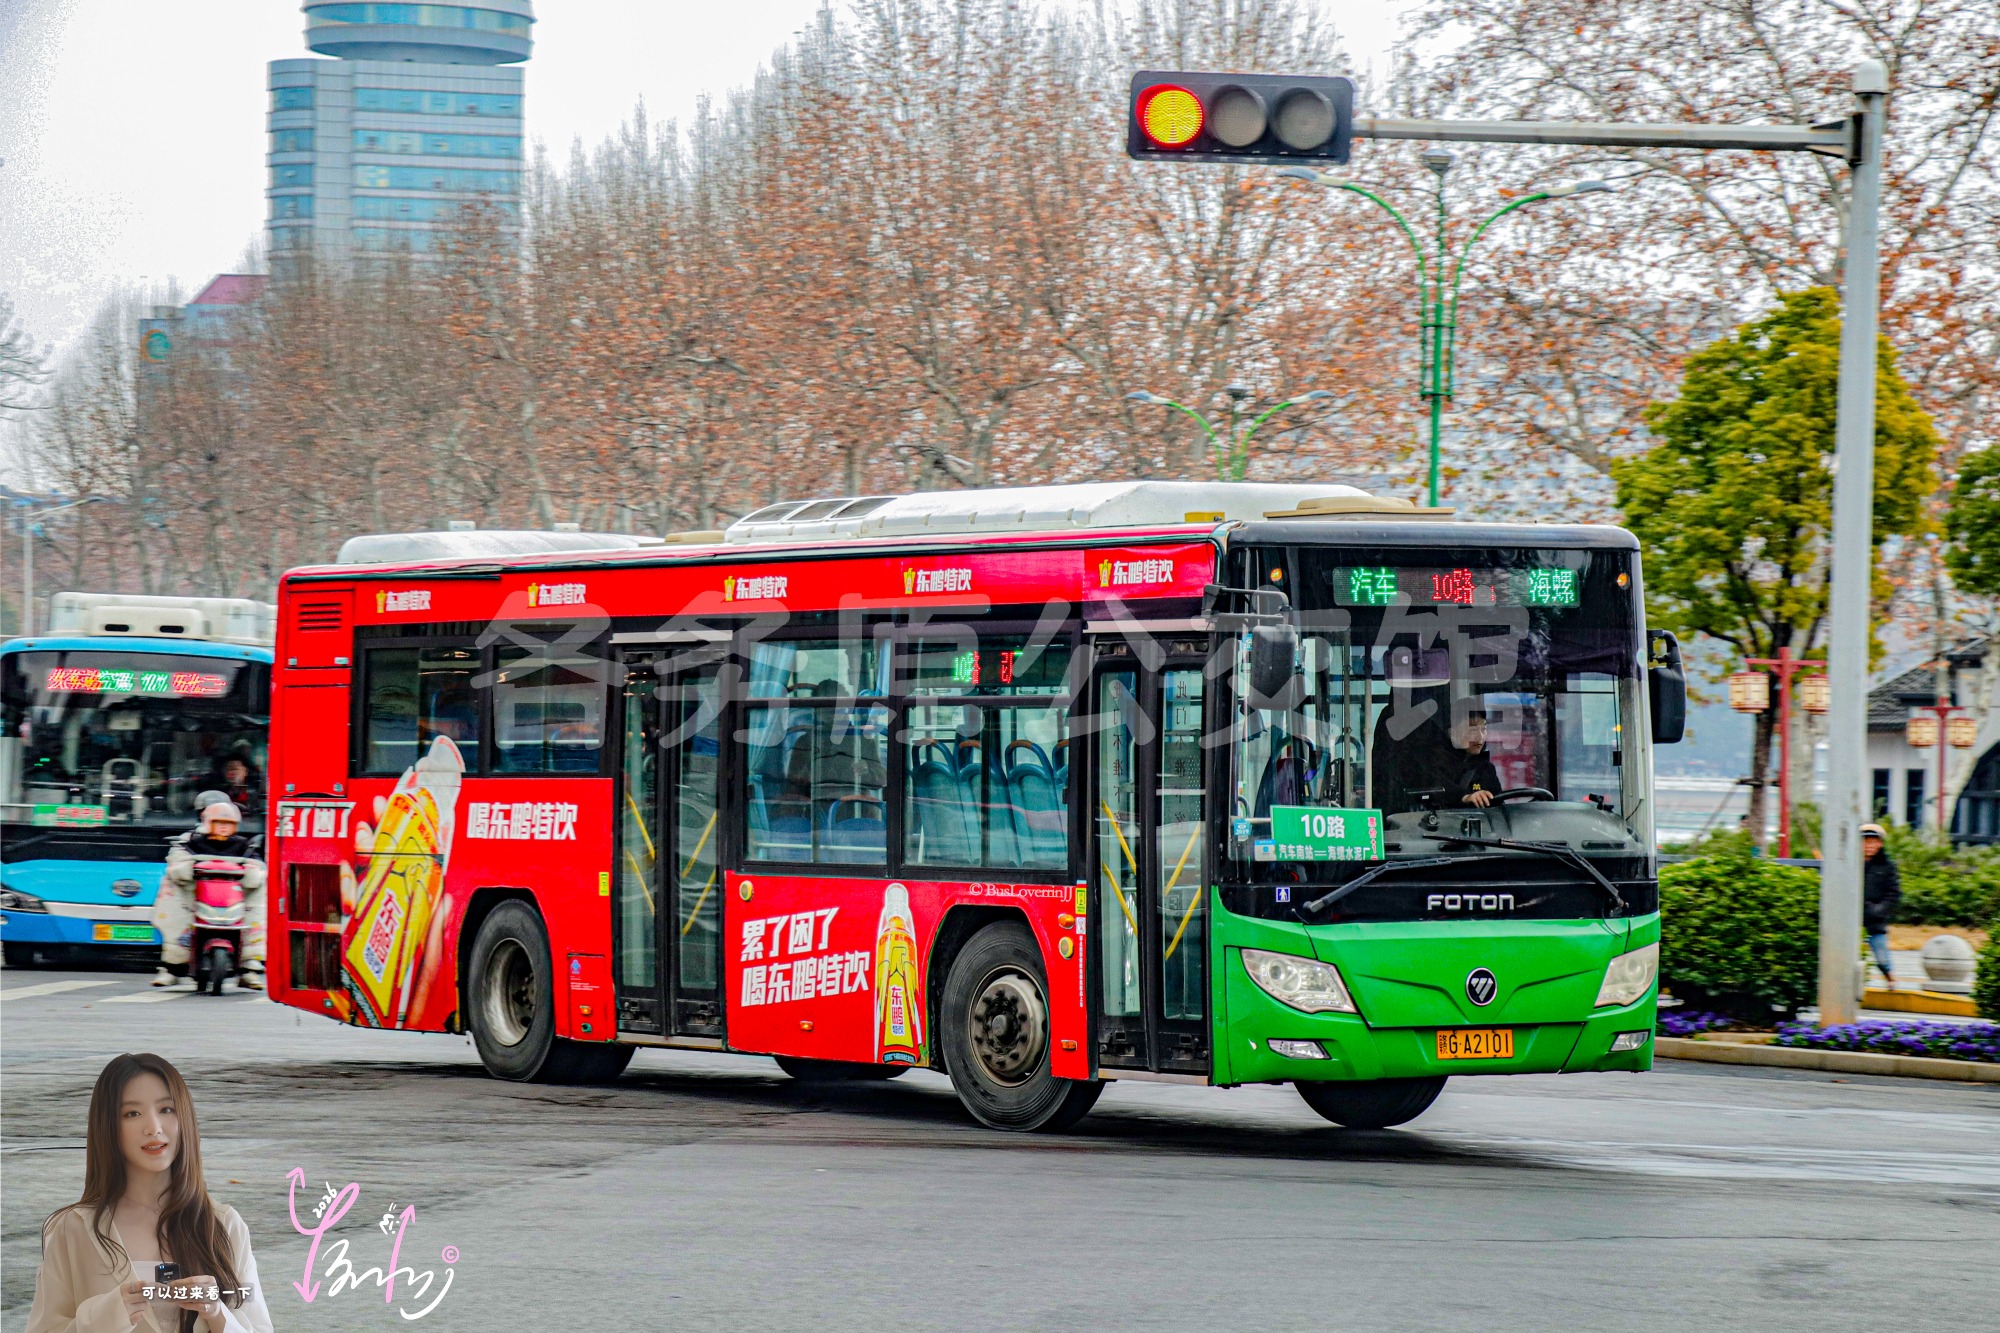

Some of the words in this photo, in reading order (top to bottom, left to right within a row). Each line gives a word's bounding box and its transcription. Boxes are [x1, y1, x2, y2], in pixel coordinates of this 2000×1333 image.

[916, 568, 972, 592] 东鹏特饮
[1113, 559, 1174, 585] 东鹏特饮
[538, 583, 587, 605] 东鹏特饮
[735, 576, 788, 599] 东鹏特饮
[1350, 568, 1397, 603] 汽车
[1431, 568, 1475, 604] 10路
[1528, 568, 1575, 604] 海螺
[273, 801, 357, 838] 累了困了
[467, 802, 578, 840] 喝东鹏特饮
[1301, 814, 1345, 838] 10路
[1427, 894, 1515, 911] FOTON
[740, 906, 840, 962] 累了困了
[740, 950, 871, 1007] 喝东鹏特饮
